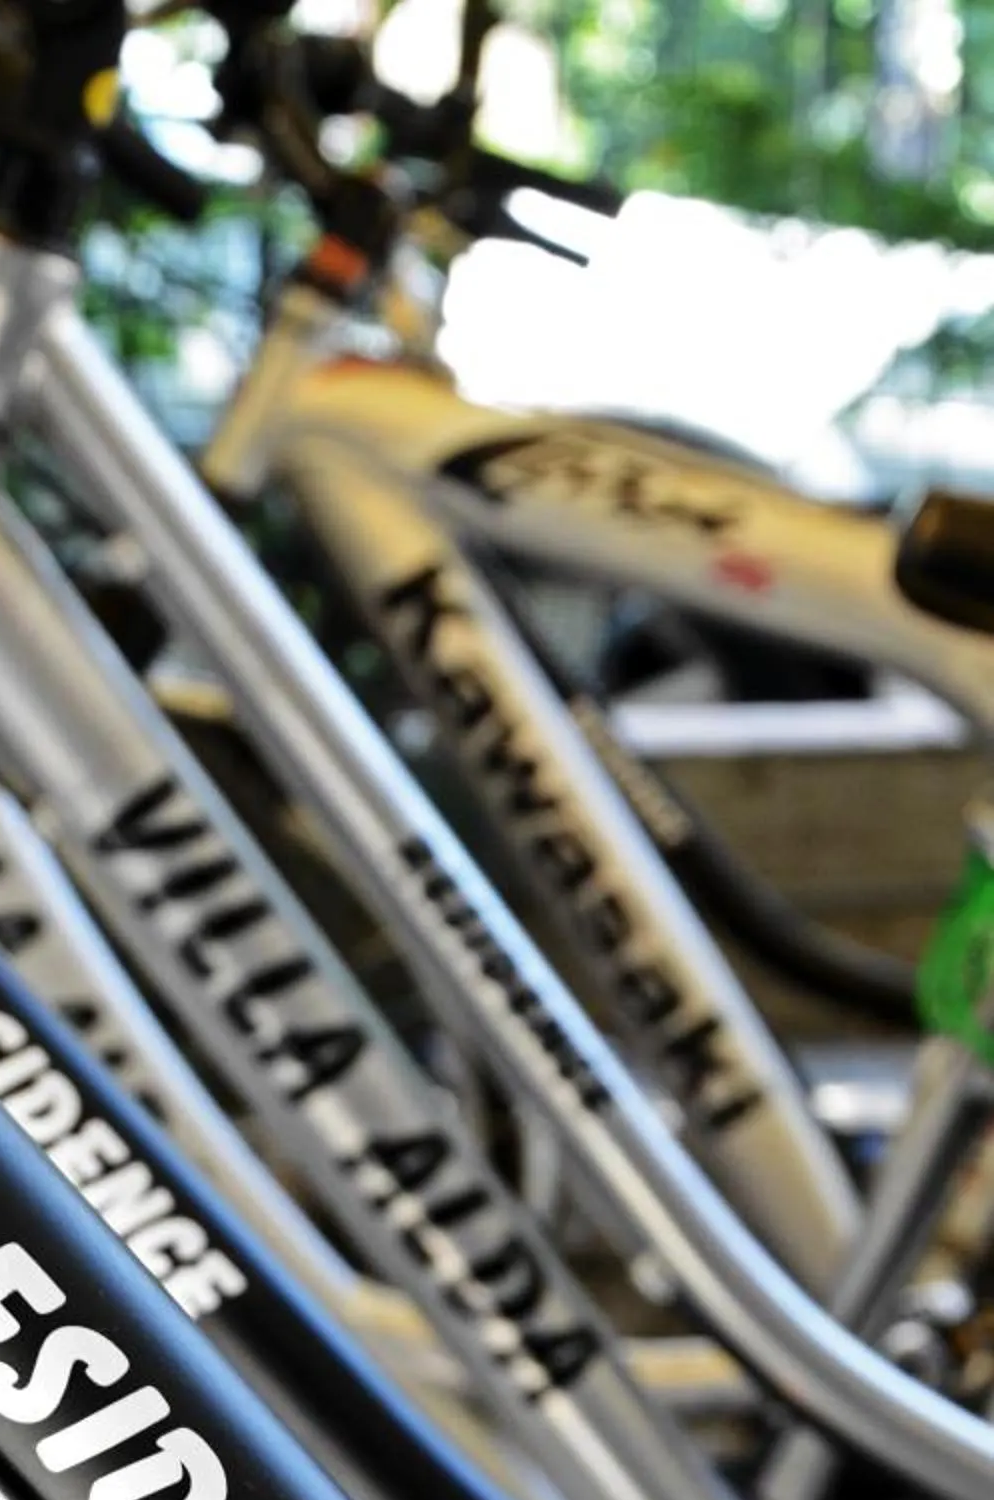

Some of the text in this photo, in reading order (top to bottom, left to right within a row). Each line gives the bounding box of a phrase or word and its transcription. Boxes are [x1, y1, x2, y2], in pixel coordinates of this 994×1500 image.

[92, 773, 370, 1102] VILLA
[334, 1128, 602, 1406] ALDA
[384, 565, 762, 1133] Kawasaki
